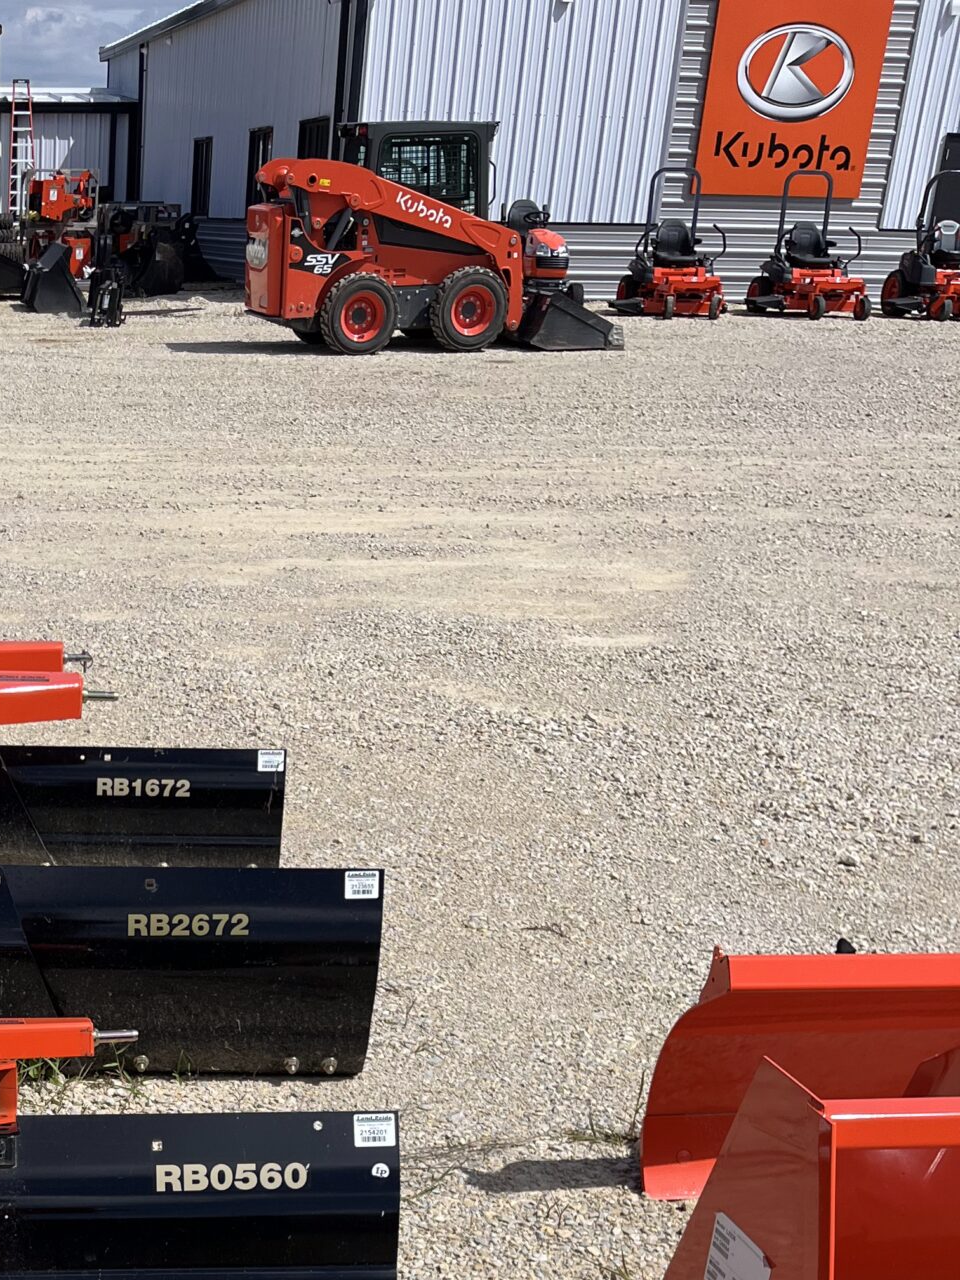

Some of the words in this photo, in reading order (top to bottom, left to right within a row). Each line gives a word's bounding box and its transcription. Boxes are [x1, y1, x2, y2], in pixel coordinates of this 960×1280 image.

[714, 131, 851, 170] Kubota
[396, 191, 452, 229] Kubota
[304, 253, 340, 265] SSV
[313, 265, 332, 274] 65
[96, 777, 191, 798] RB1672
[127, 913, 249, 937] RB2672
[155, 1162, 308, 1192] RB0560
